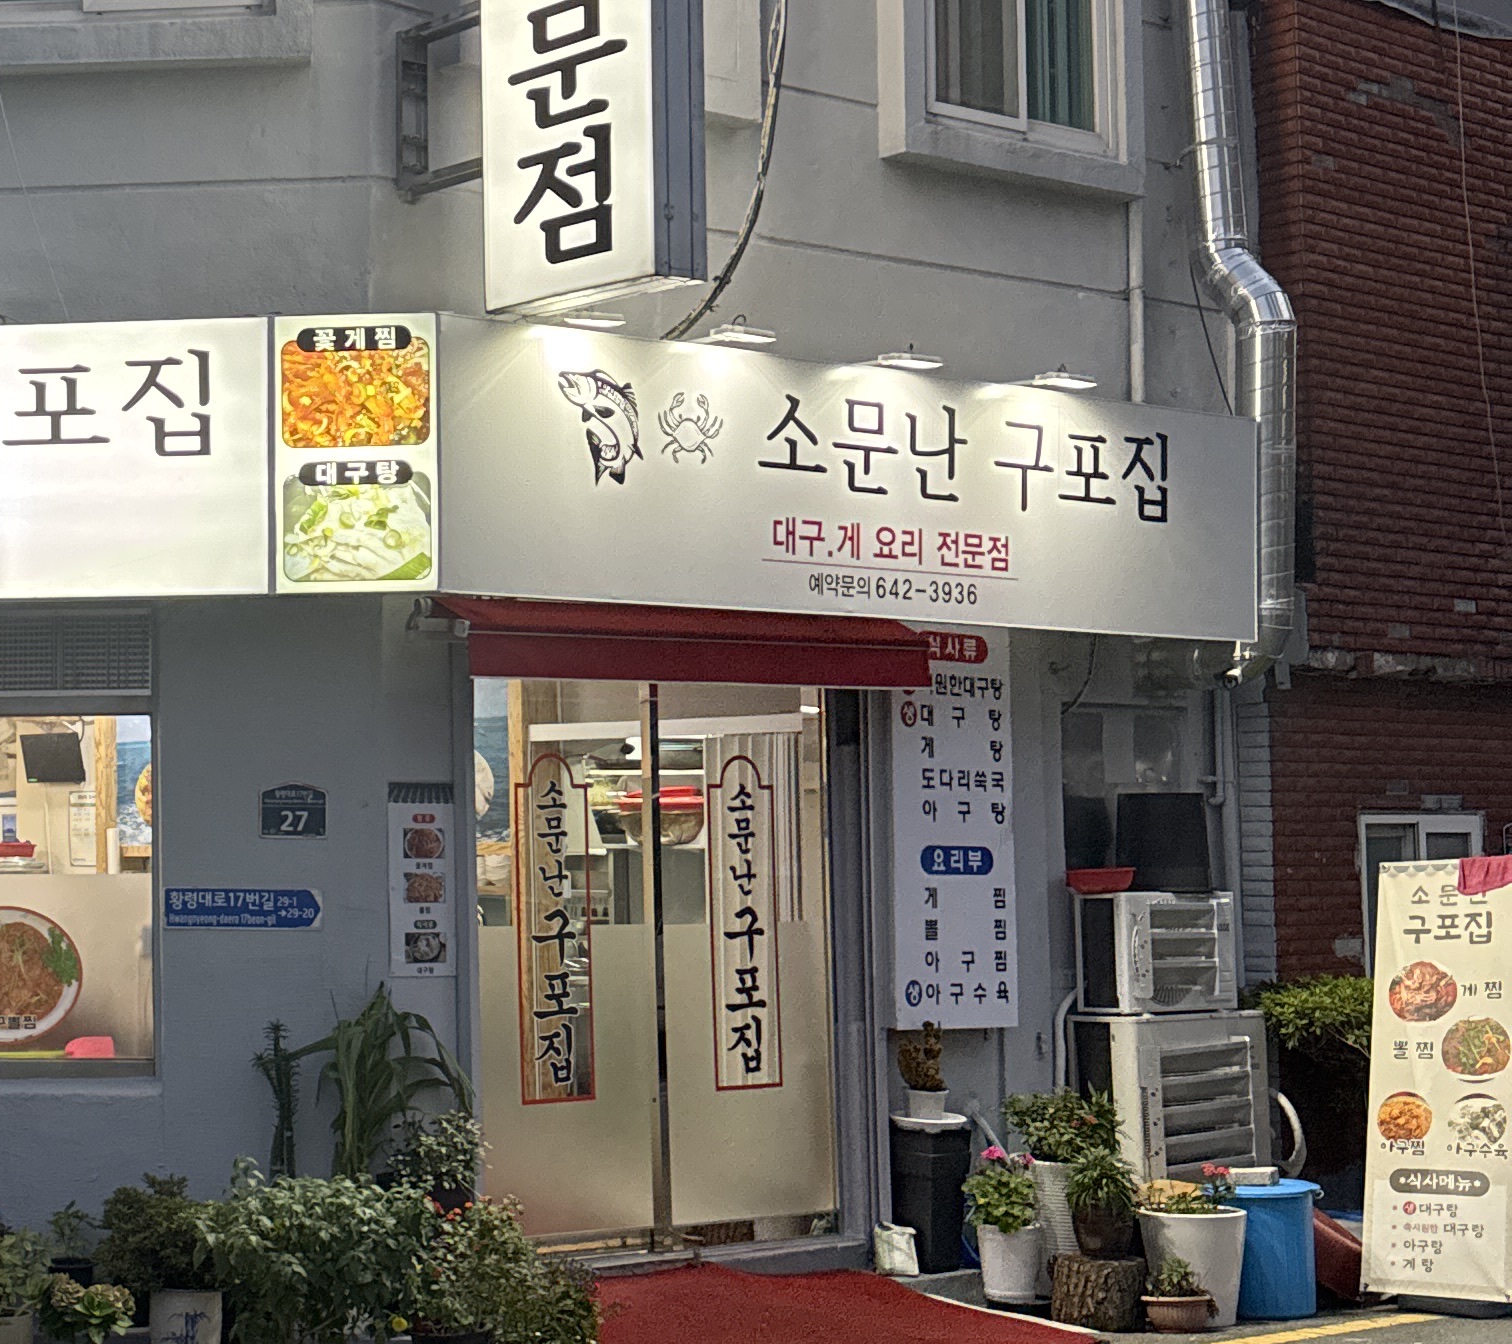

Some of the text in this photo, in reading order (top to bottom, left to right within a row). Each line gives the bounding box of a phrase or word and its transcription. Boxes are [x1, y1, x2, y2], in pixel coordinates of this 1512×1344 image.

[757, 393, 1170, 524] 소문난 구포집
[314, 462, 400, 485] 대구탕
[873, 523, 925, 565] 요리
[936, 532, 1011, 573] 전문점
[875, 575, 979, 607] 642-3936
[930, 673, 1003, 700] 원한대구탕
[280, 810, 309, 832] 27
[932, 848, 982, 872] 요리부
[169, 891, 275, 910] 황령대로17번길
[531, 779, 580, 1085] 소문난 구포집
[723, 783, 767, 1074] 소문난 구포집
[1403, 911, 1492, 945] 구포집
[1381, 1140, 1425, 1156] 아구찜
[1446, 1143, 1509, 1160] 아구수육
[1407, 1173, 1473, 1192] 식사메뉴
[1419, 1202, 1458, 1218] 대구탕
[1443, 1222, 1485, 1239] 대구탕
[1403, 1238, 1443, 1255] 아구탕
